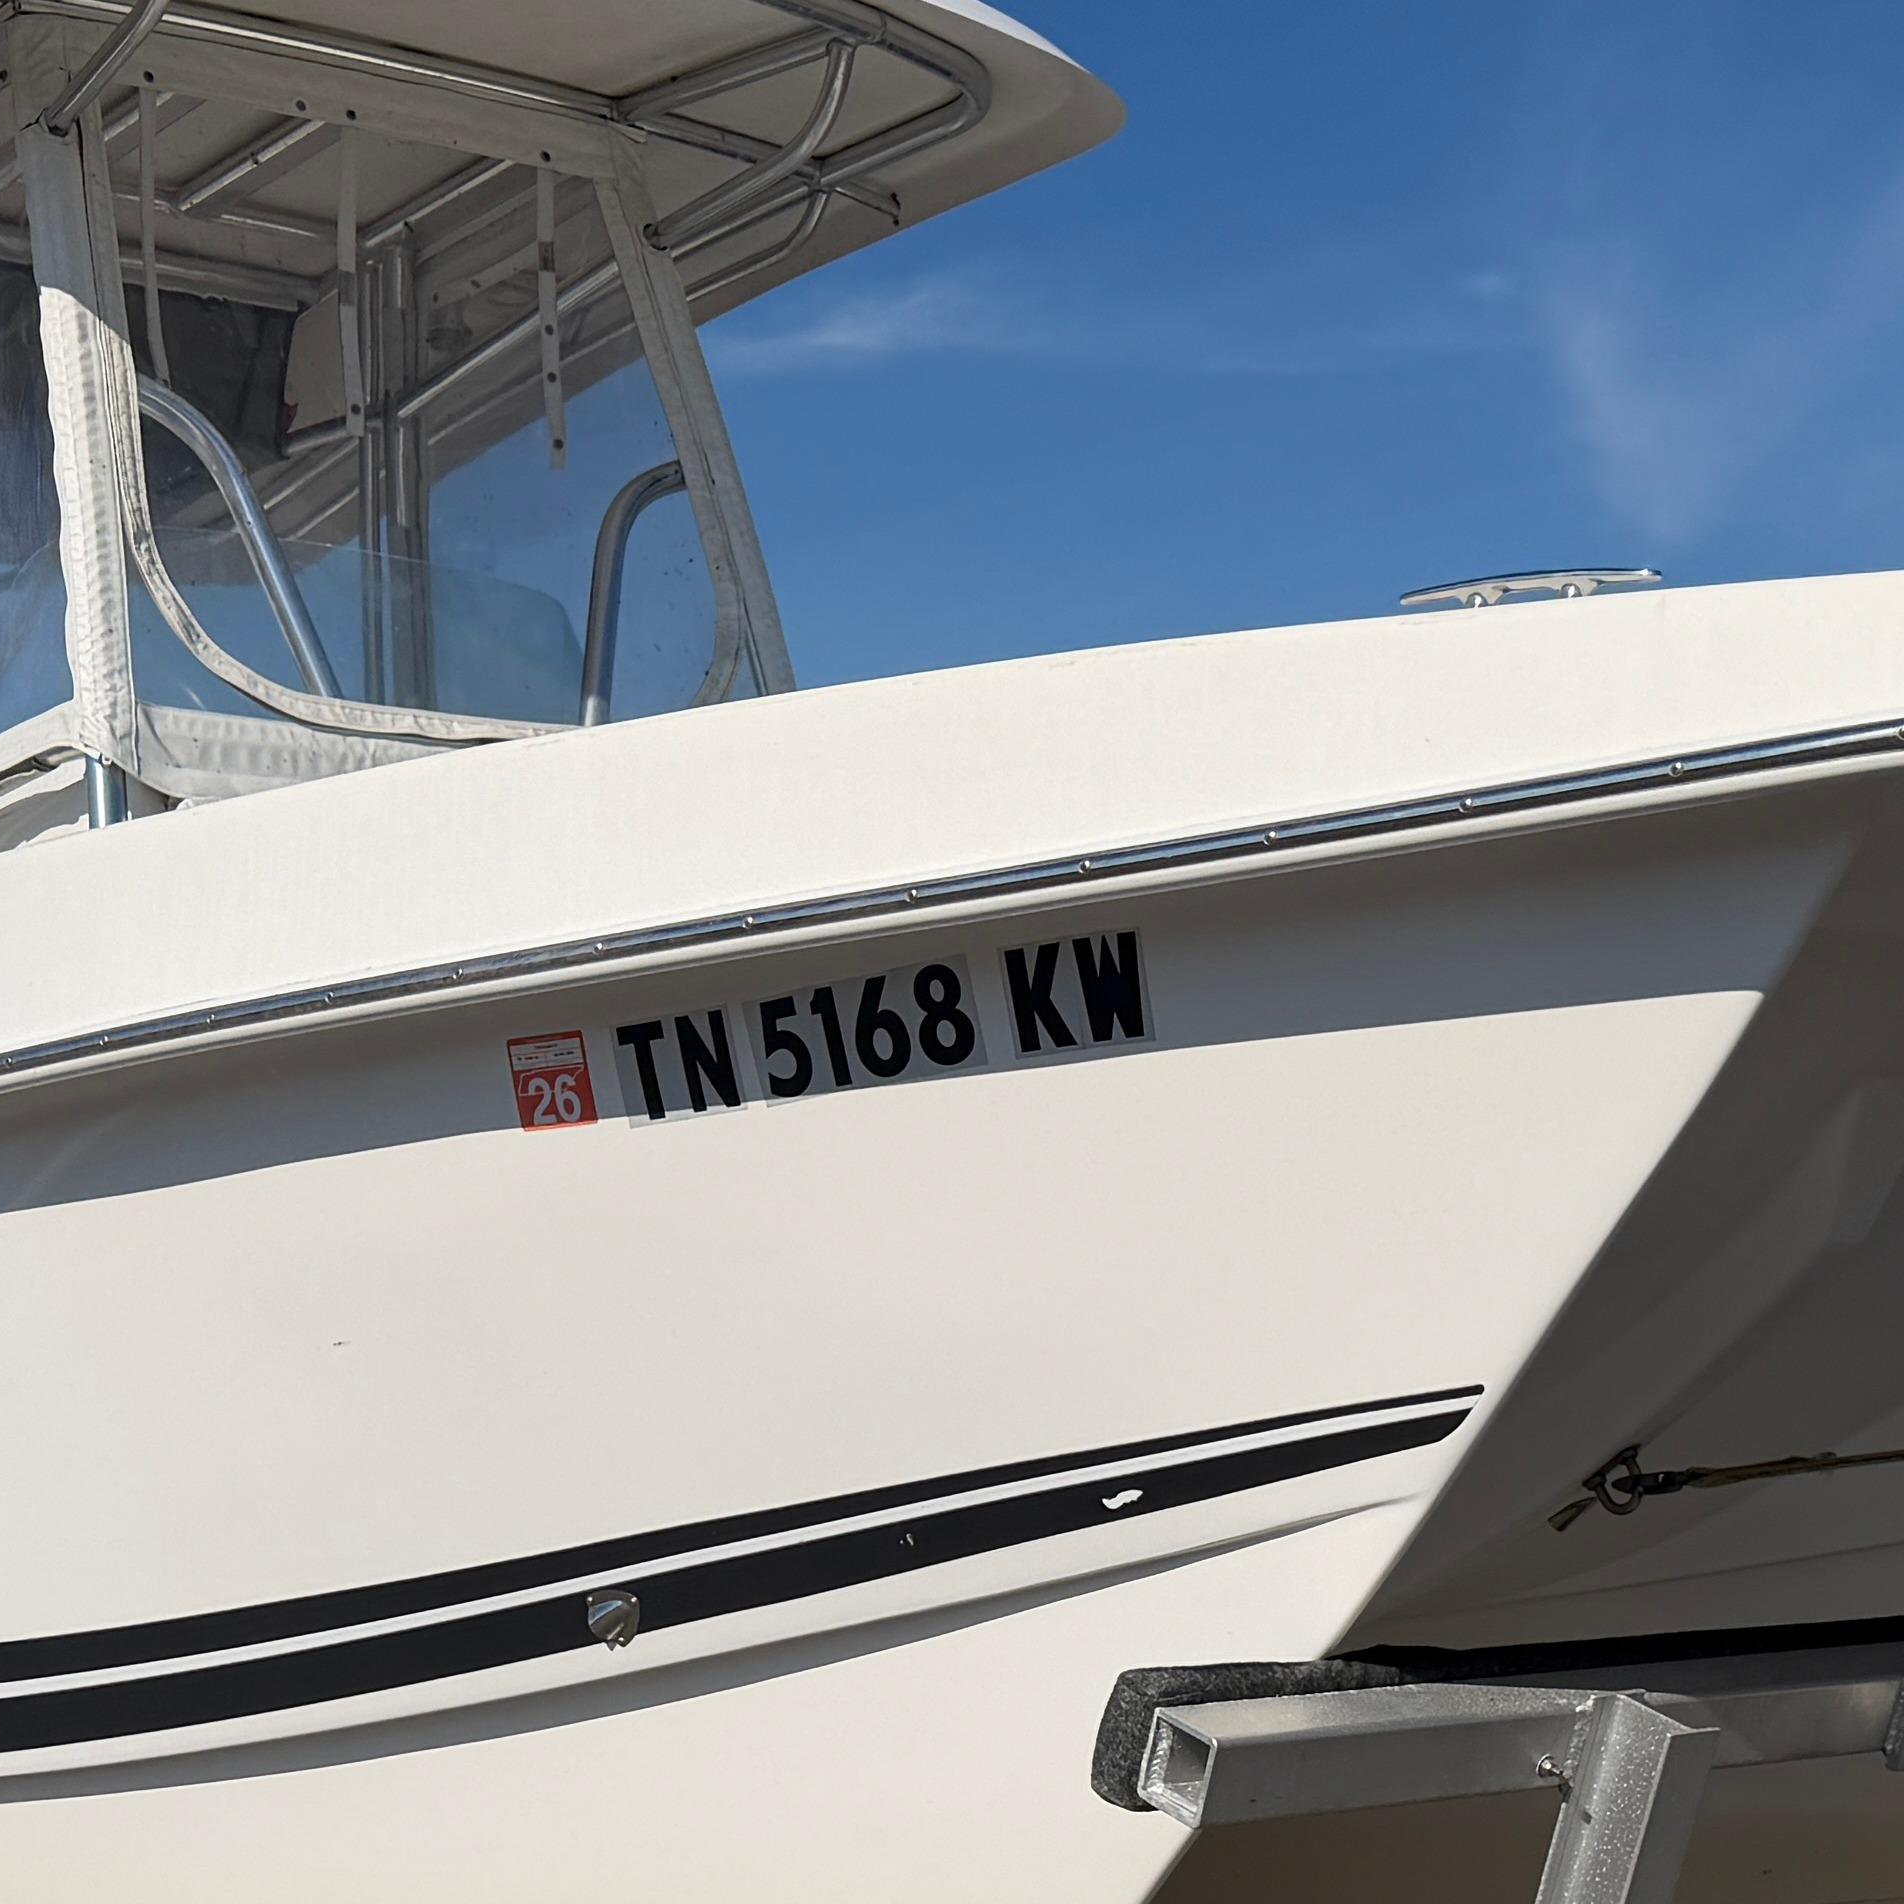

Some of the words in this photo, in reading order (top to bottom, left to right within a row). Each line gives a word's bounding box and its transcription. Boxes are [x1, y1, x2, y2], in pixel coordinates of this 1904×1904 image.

[616, 1009, 743, 1120] TN
[759, 963, 977, 1099] 5168
[1004, 930, 1146, 1053] KW
[528, 1073, 581, 1125] 26
